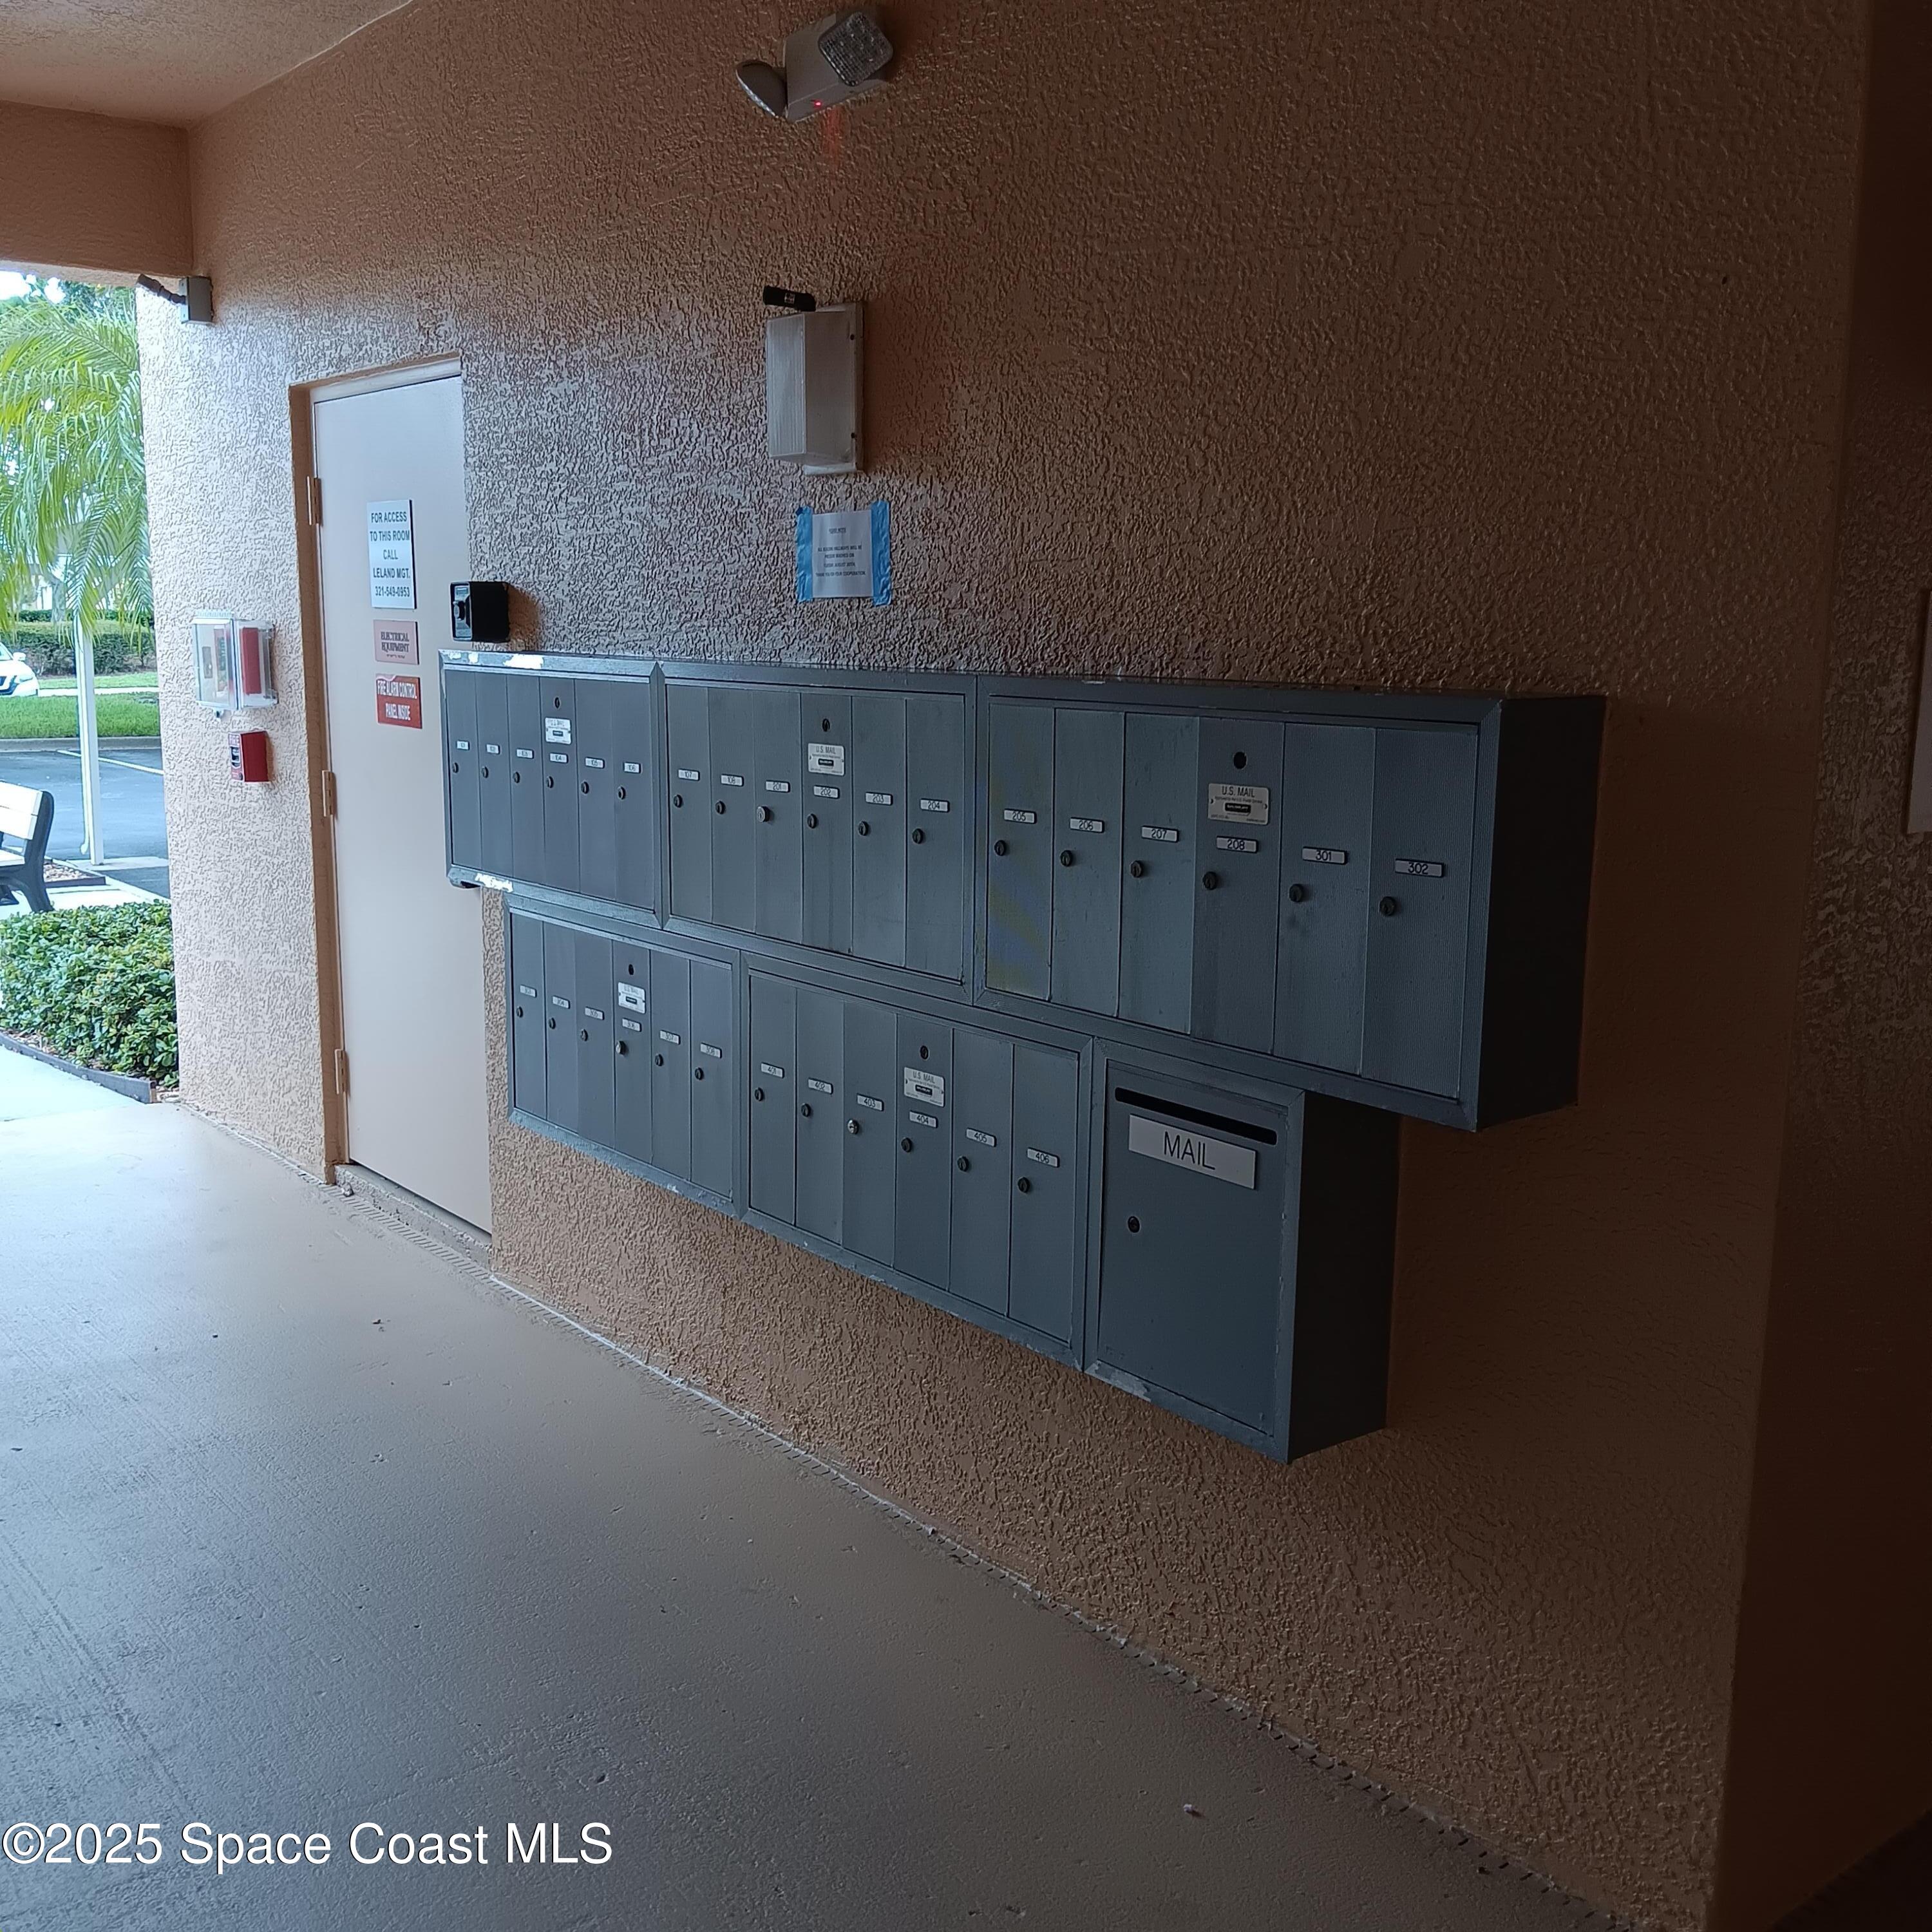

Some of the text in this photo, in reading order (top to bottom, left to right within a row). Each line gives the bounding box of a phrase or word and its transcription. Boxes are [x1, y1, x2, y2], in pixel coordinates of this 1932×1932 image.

[371, 511, 407, 523] FOR ACCESS
[370, 530, 410, 542] TO THIS ROOM
[383, 549, 399, 560] CALL
[373, 567, 411, 579] LELAND MGT.
[381, 632, 410, 642] ELECTRICAL
[382, 642, 410, 653] EQUIPMENT
[377, 680, 386, 696] FIRE
[386, 703, 397, 719] PANEL
[773, 782, 782, 791] 201
[1222, 786, 1255, 798] U.S. MAIL
[820, 788, 831, 797] 202
[873, 794, 884, 804] 203
[928, 802, 940, 810] 204
[1012, 811, 1026, 821] 205
[1079, 820, 1094, 831] 206
[1151, 829, 1167, 839] 207
[1227, 840, 1245, 850] 208
[1316, 850, 1332, 861] 301
[1408, 863, 1428, 875] 302
[923, 1073, 935, 1084] MAIL
[815, 1081, 826, 1092] 402
[864, 1098, 876, 1108] 403
[916, 1113, 929, 1125] 404
[974, 1132, 987, 1143] 405
[1164, 1131, 1215, 1170] MAIL
[1035, 1152, 1049, 1164] 406
